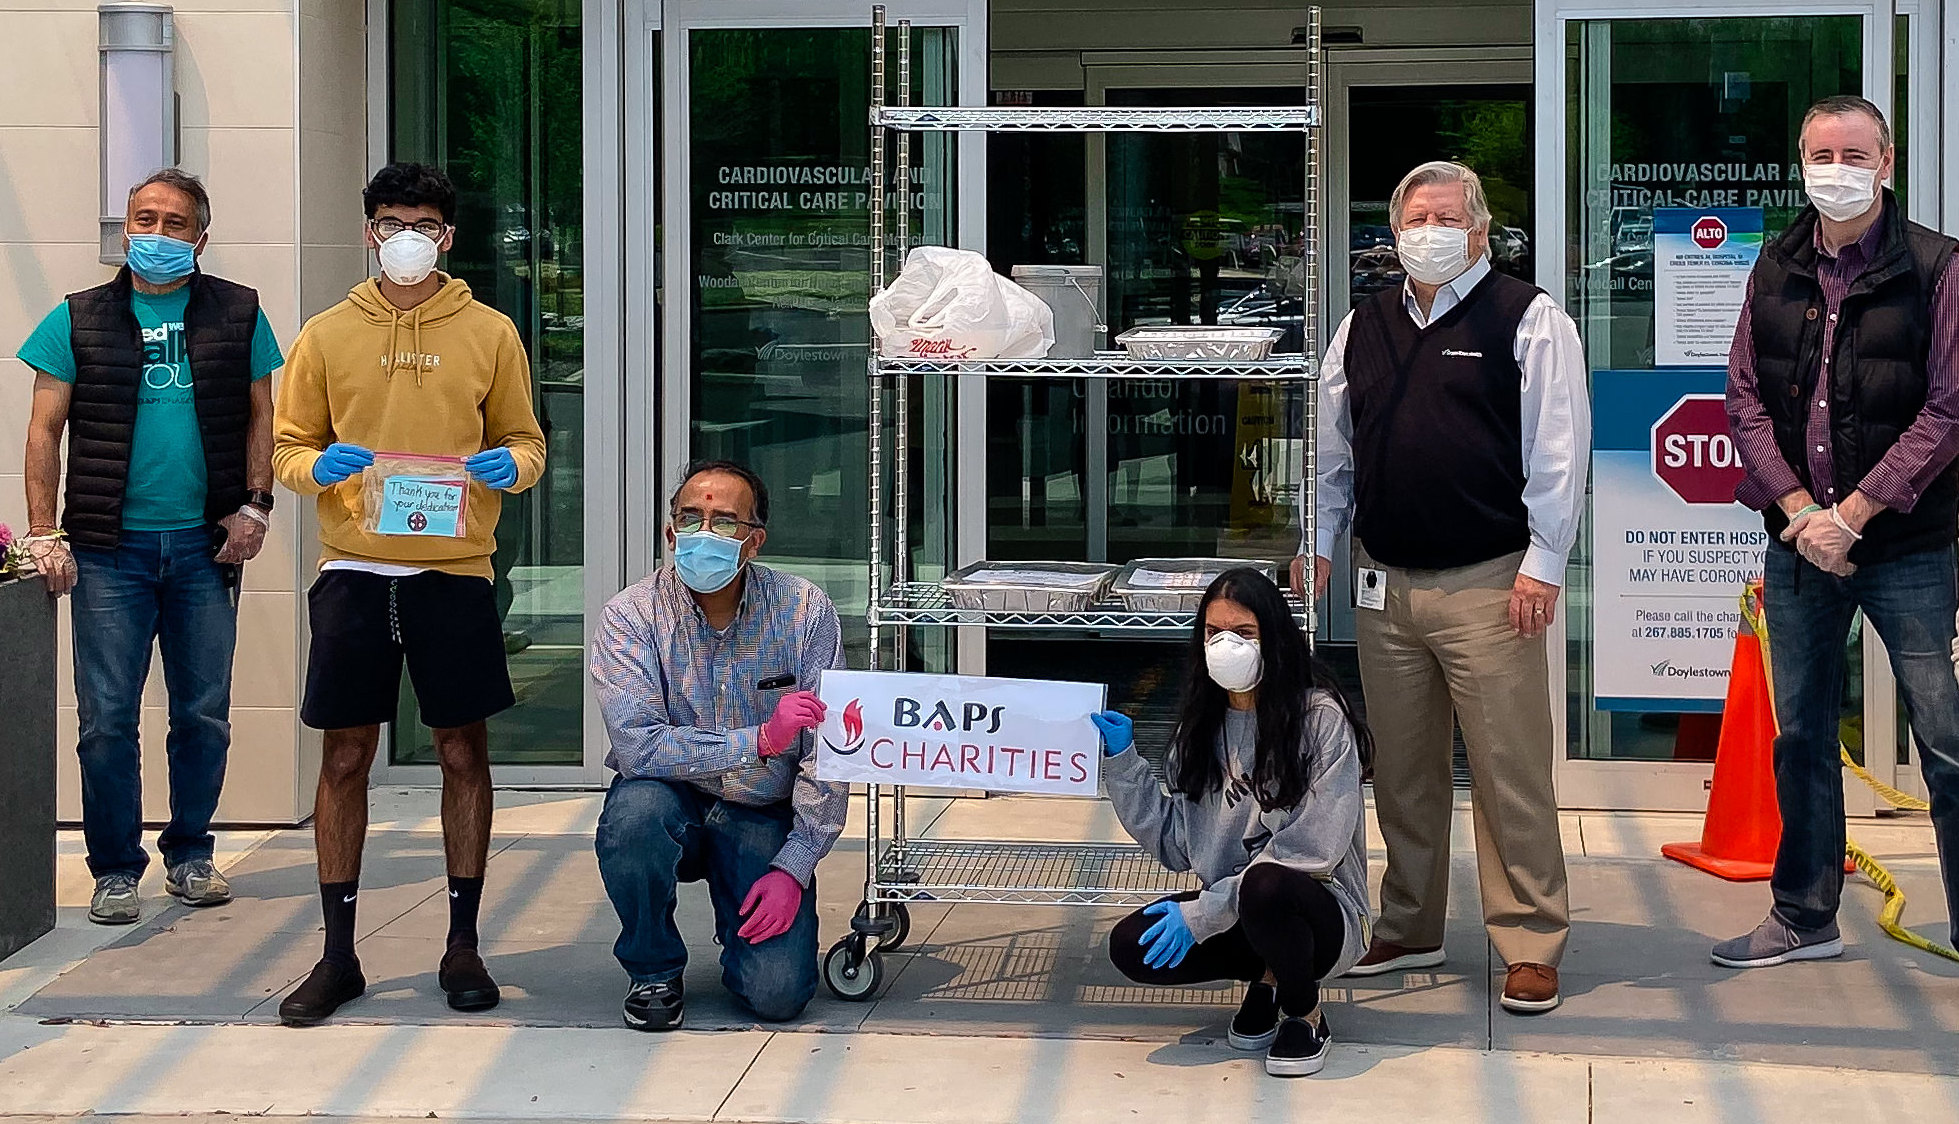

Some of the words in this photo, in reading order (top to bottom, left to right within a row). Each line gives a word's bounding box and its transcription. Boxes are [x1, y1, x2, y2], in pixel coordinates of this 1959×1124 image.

[718, 166, 888, 185] CARDIOVASCULA
[1597, 163, 1780, 182] CARDIOVASCULAR
[708, 191, 793, 210] CRITICAL
[799, 191, 849, 210] CARE
[1685, 189, 1739, 207] CARE
[713, 232, 743, 246] Clark
[746, 232, 787, 246] Center
[788, 231, 806, 246] for
[1695, 228, 1723, 239] ALTO
[389, 481, 423, 498] Thank
[425, 487, 440, 501] you
[444, 487, 458, 501] for
[393, 500, 415, 512] your
[1625, 530, 1645, 544] DO
[1649, 530, 1677, 544] NOT
[1680, 530, 1725, 545] ENTER
[1730, 531, 1767, 545] HOSP
[1642, 549, 1655, 563] IF
[1658, 550, 1685, 563] YOU
[1688, 550, 1749, 564] SUSPECT
[1629, 568, 1658, 582] MAY
[1661, 569, 1696, 583] HAVE
[1636, 609, 1671, 622] Please
[1674, 609, 1693, 622] call
[1696, 610, 1714, 622] the
[1631, 627, 1642, 638] at
[1645, 627, 1724, 639] 267.885.1705
[1667, 665, 1732, 680] Doylestown
[893, 697, 1006, 734] BAPS
[870, 737, 1088, 784] CHARITIES
